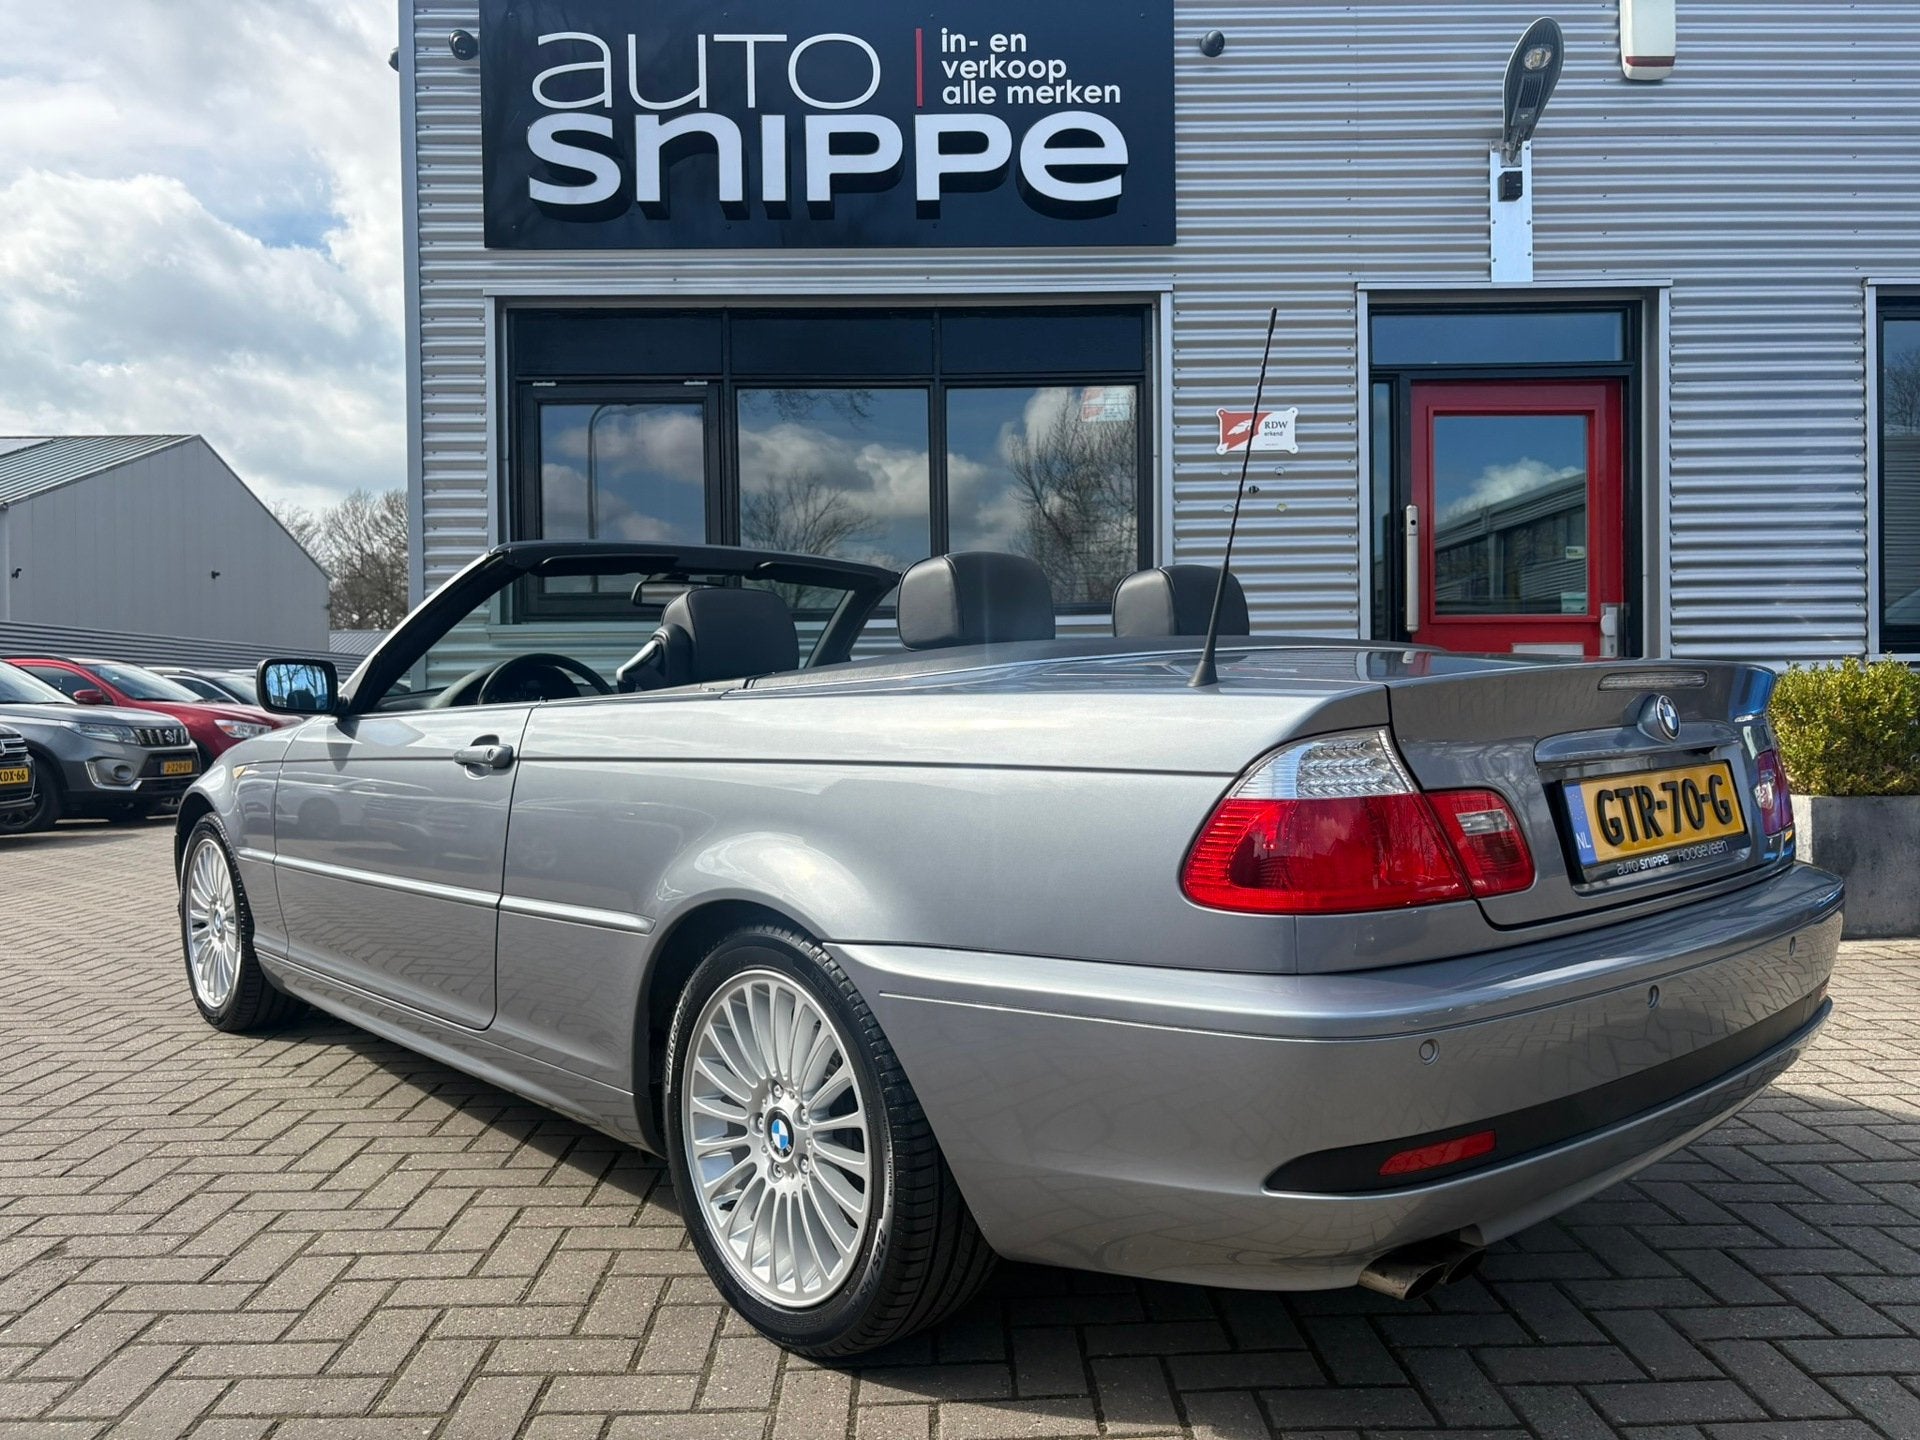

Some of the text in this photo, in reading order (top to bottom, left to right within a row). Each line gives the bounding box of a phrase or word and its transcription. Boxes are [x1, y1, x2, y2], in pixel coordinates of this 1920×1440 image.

[941, 27, 1027, 53] in- en
[941, 54, 1067, 84] verkoop
[942, 79, 1121, 105] alle merken
[1264, 421, 1288, 430] RDW
[1596, 775, 1733, 846] GTR-70-G
[1576, 834, 1592, 850] NL
